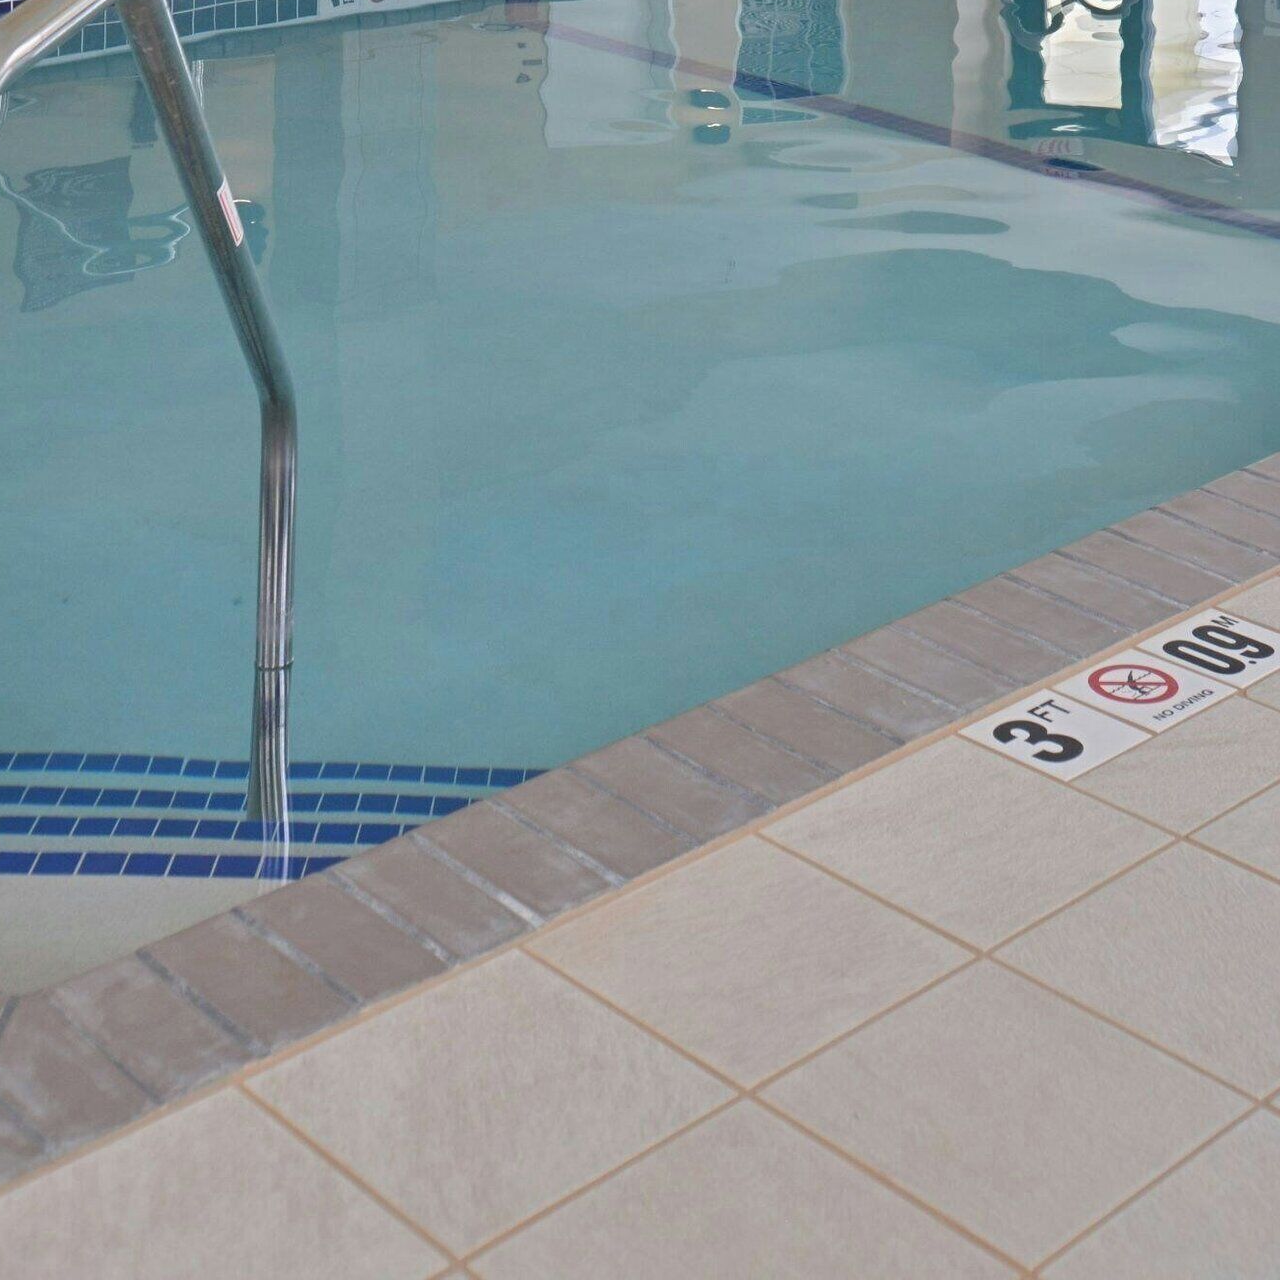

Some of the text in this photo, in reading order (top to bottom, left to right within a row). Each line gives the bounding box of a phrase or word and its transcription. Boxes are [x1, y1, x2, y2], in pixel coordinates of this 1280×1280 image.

[1211, 615, 1240, 629] M
[1152, 689, 1214, 721] NO DIVING
[992, 698, 1084, 763] 3 FT
